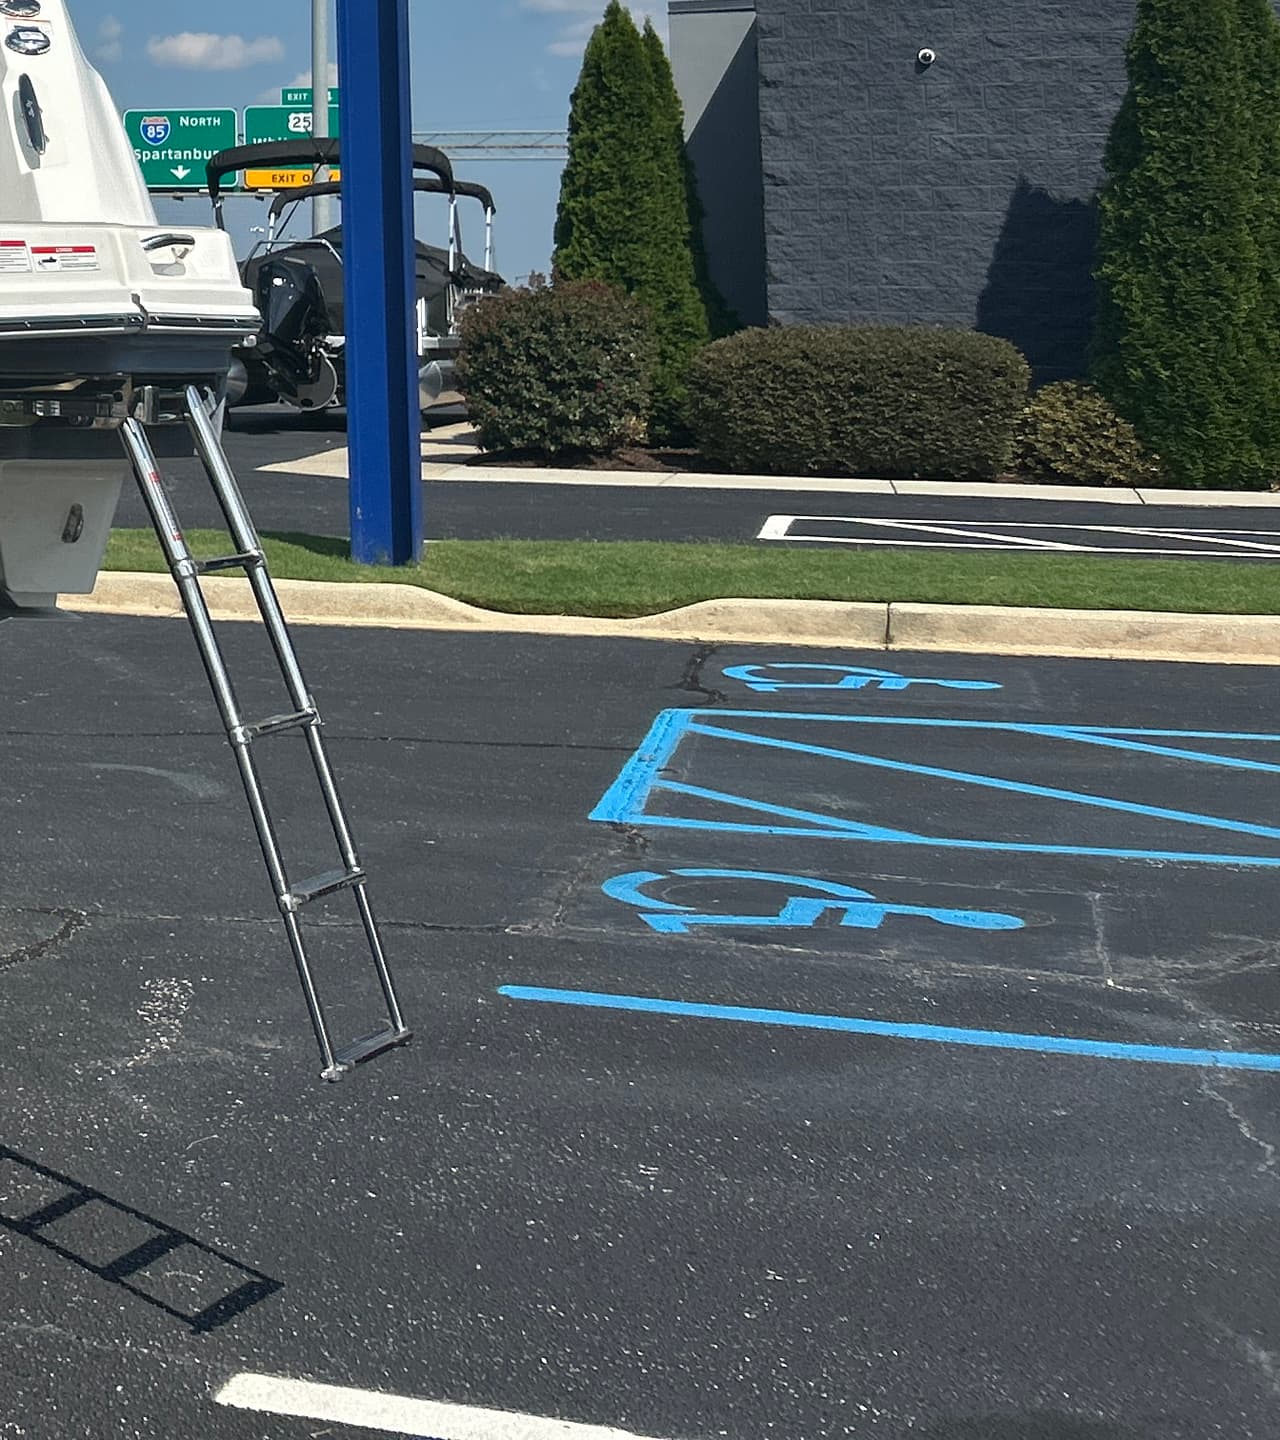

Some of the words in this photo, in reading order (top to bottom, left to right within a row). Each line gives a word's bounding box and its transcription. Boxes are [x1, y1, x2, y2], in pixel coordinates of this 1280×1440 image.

[287, 92, 308, 101] EXIT
[179, 115, 221, 127] NORTH
[292, 116, 312, 129] 25
[146, 125, 165, 138] 85
[134, 148, 220, 163] Spartanbur
[271, 173, 296, 183] EXIT
